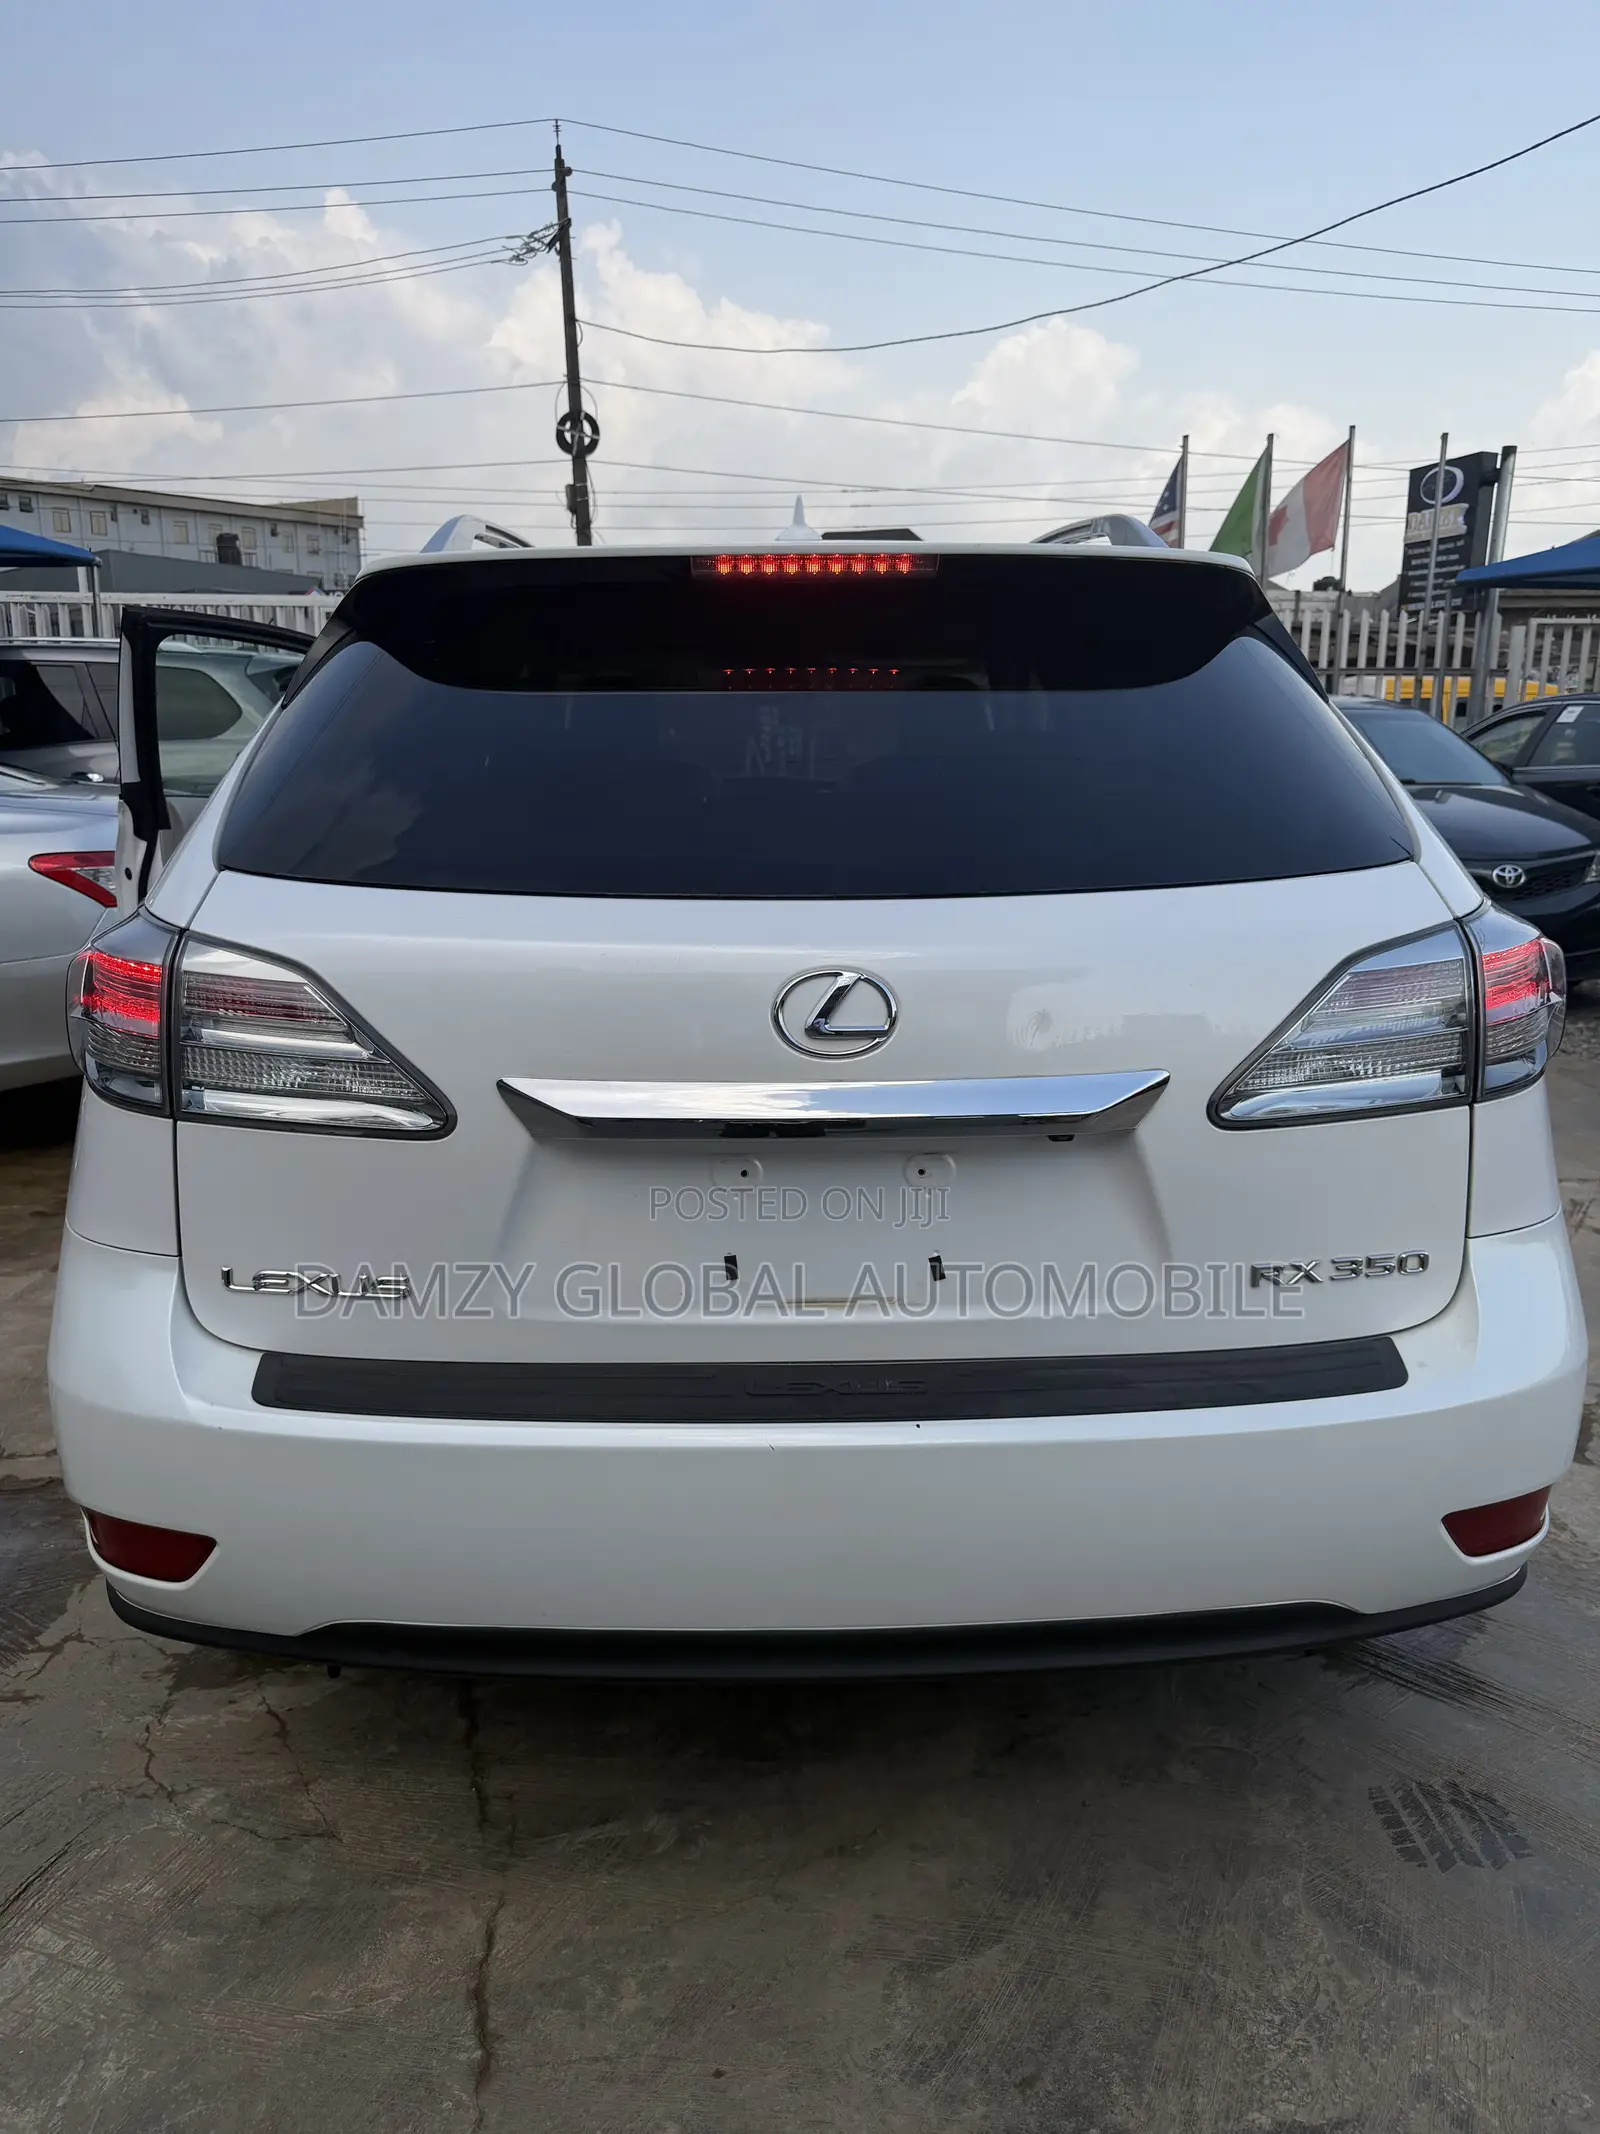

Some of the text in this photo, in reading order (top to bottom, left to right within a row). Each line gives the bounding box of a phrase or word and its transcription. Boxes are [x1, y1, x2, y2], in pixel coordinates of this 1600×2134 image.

[221, 1266, 411, 1300] LEXUS
[1251, 1250, 1430, 1289] RX 350
